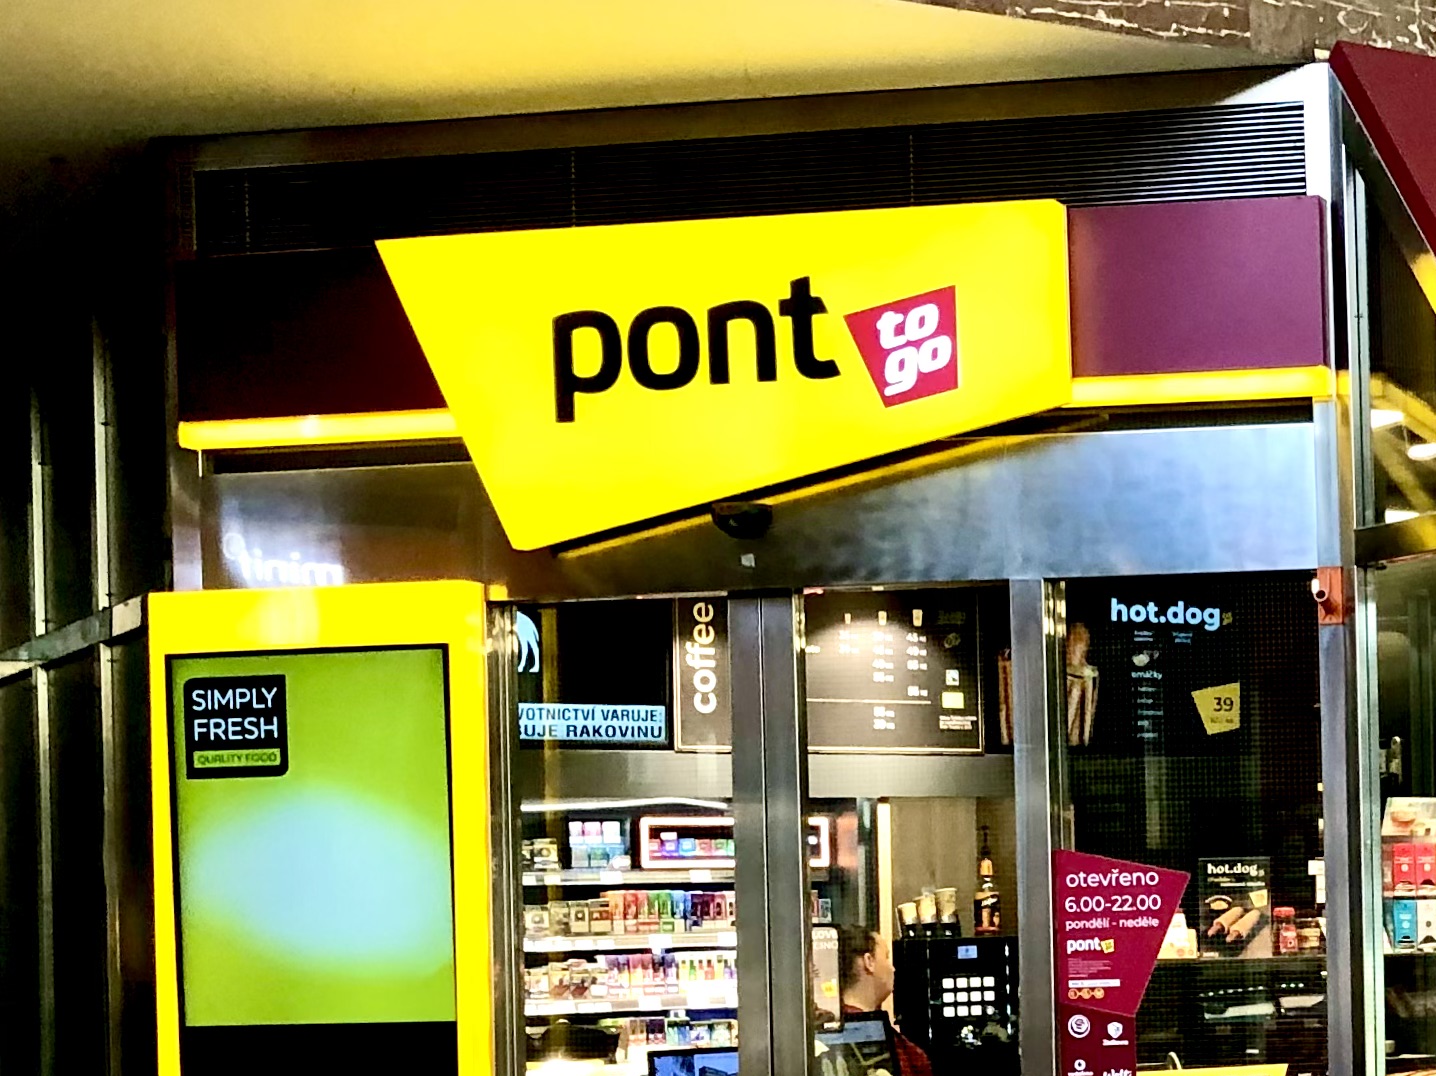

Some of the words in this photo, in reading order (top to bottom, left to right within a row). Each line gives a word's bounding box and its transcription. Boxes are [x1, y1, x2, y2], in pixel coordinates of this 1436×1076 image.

[876, 302, 939, 350] to
[552, 276, 841, 423] pont
[883, 334, 953, 397] go
[1111, 598, 1220, 631] hot.dog
[685, 602, 717, 714] coffee
[192, 687, 277, 711] SIMPLY
[1213, 697, 1234, 712] 39
[193, 716, 278, 741] FRESH
[566, 724, 662, 738] RAKOVINU
[197, 753, 242, 765] QUALITY
[245, 752, 277, 762] FOOD
[1066, 868, 1159, 888] otevřeno
[1207, 863, 1258, 877] hot.dog
[1064, 894, 1161, 912] 6.00-22.00
[1065, 917, 1110, 931] pondělí
[1119, 916, 1159, 927] neděle
[1067, 937, 1101, 954] pont
